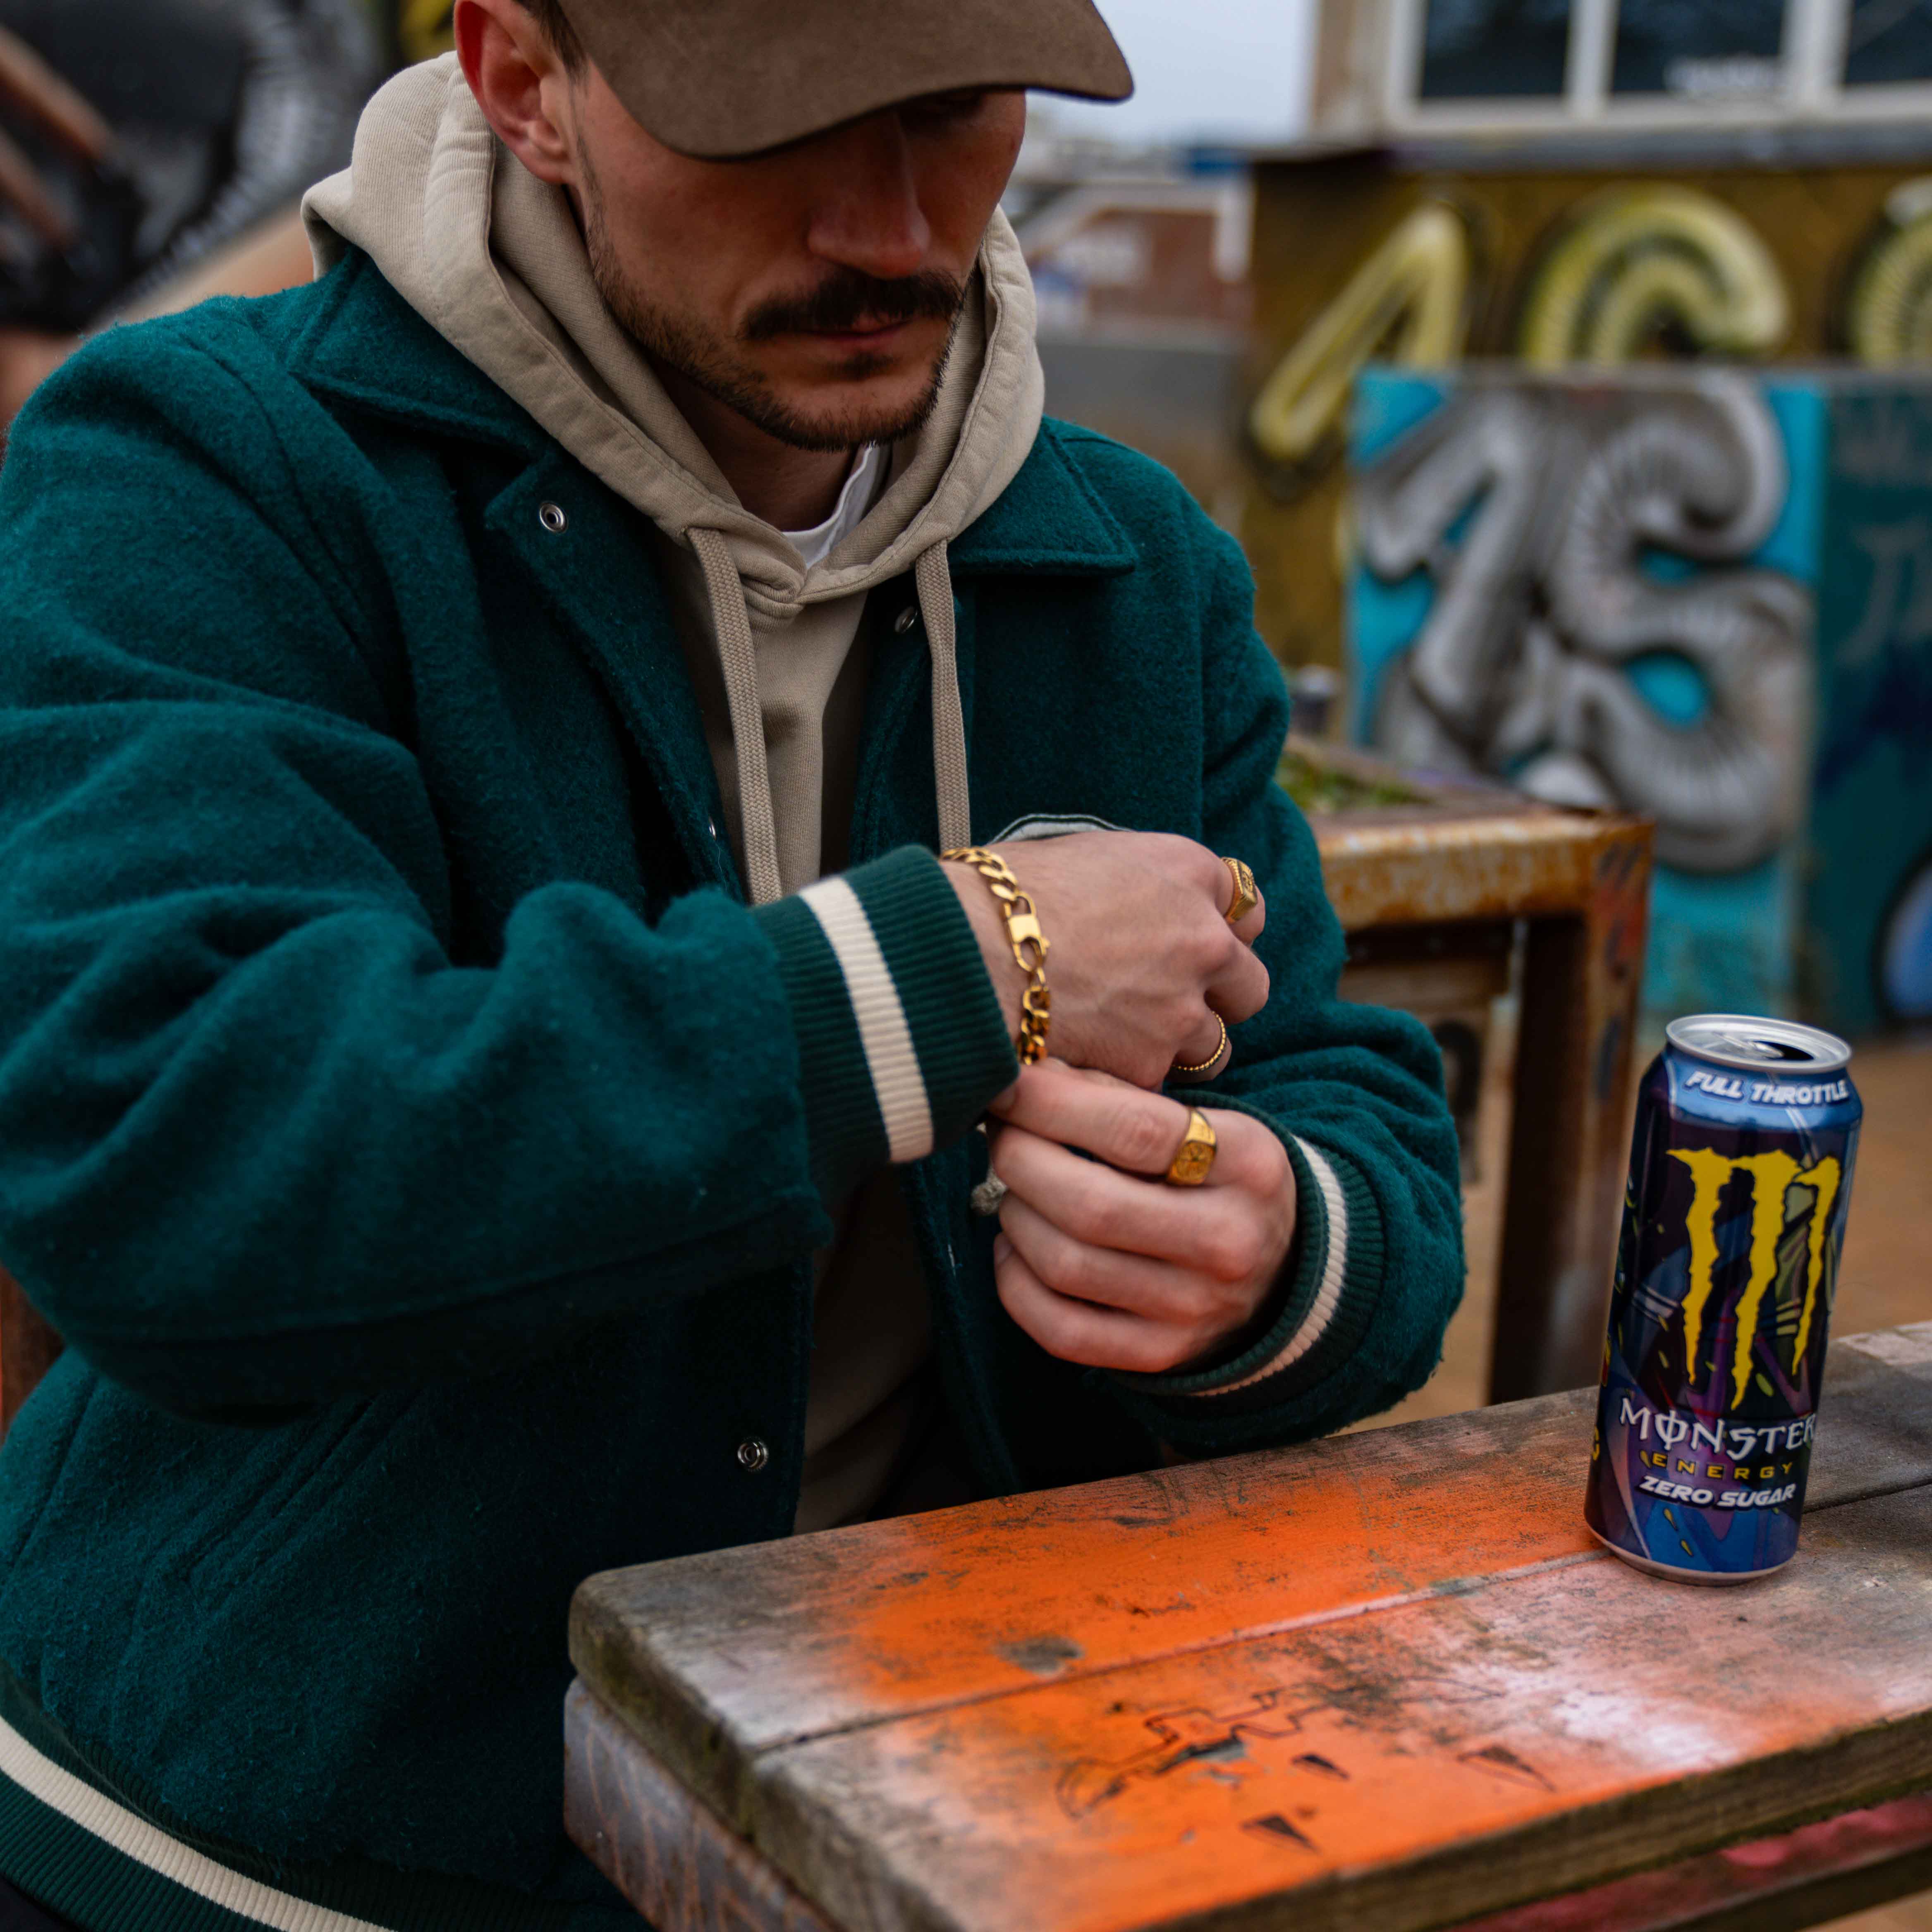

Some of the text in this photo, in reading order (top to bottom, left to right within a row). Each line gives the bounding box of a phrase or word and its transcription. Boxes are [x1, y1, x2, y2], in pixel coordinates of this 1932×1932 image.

[1685, 1071, 1848, 1105] FULL THROTTLE
[1652, 1452, 1793, 1480] ENERGY
[1639, 1475, 1796, 1507] ZERO SUGAR
